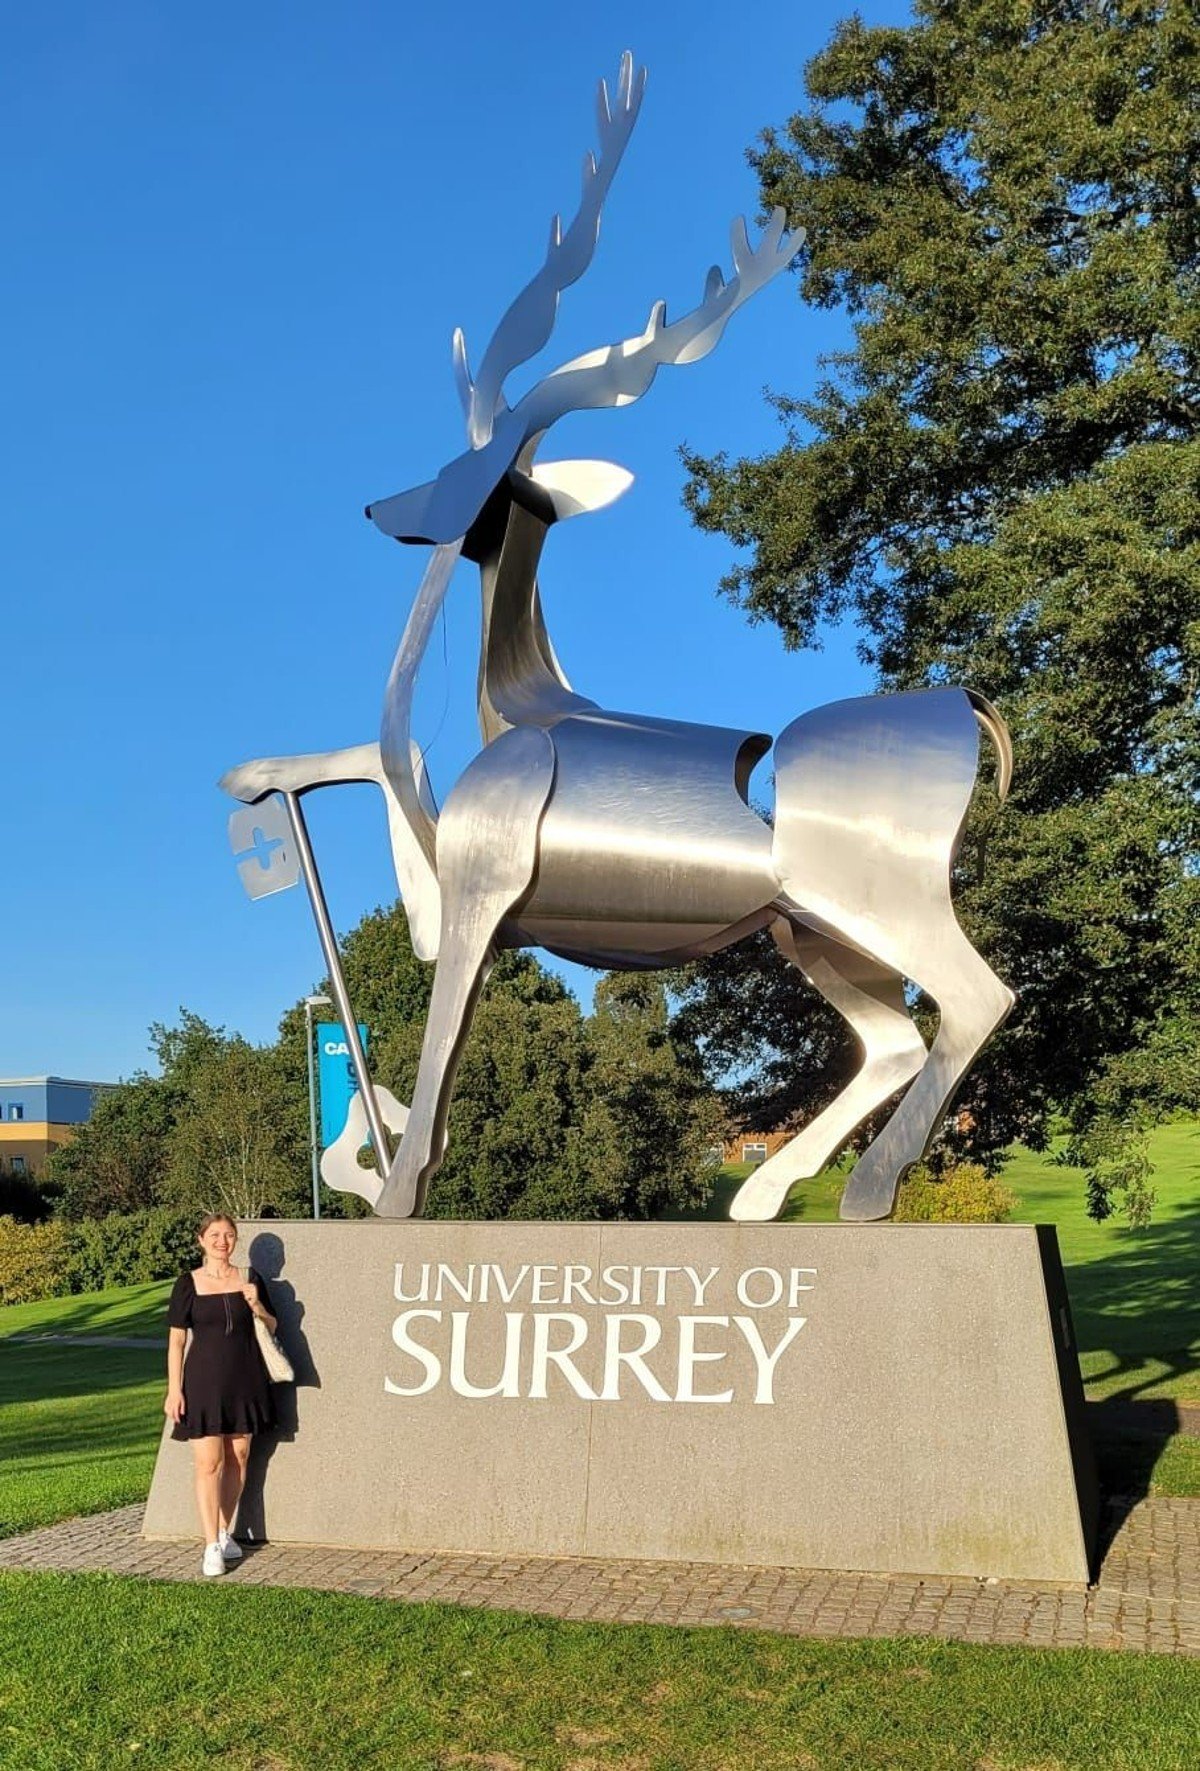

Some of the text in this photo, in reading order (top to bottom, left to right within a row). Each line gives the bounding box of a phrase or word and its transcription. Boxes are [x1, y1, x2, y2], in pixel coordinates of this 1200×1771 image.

[324, 1042, 350, 1056] CA
[393, 1263, 819, 1309] UNIVERSITY OF
[383, 1309, 808, 1405] SURREY
